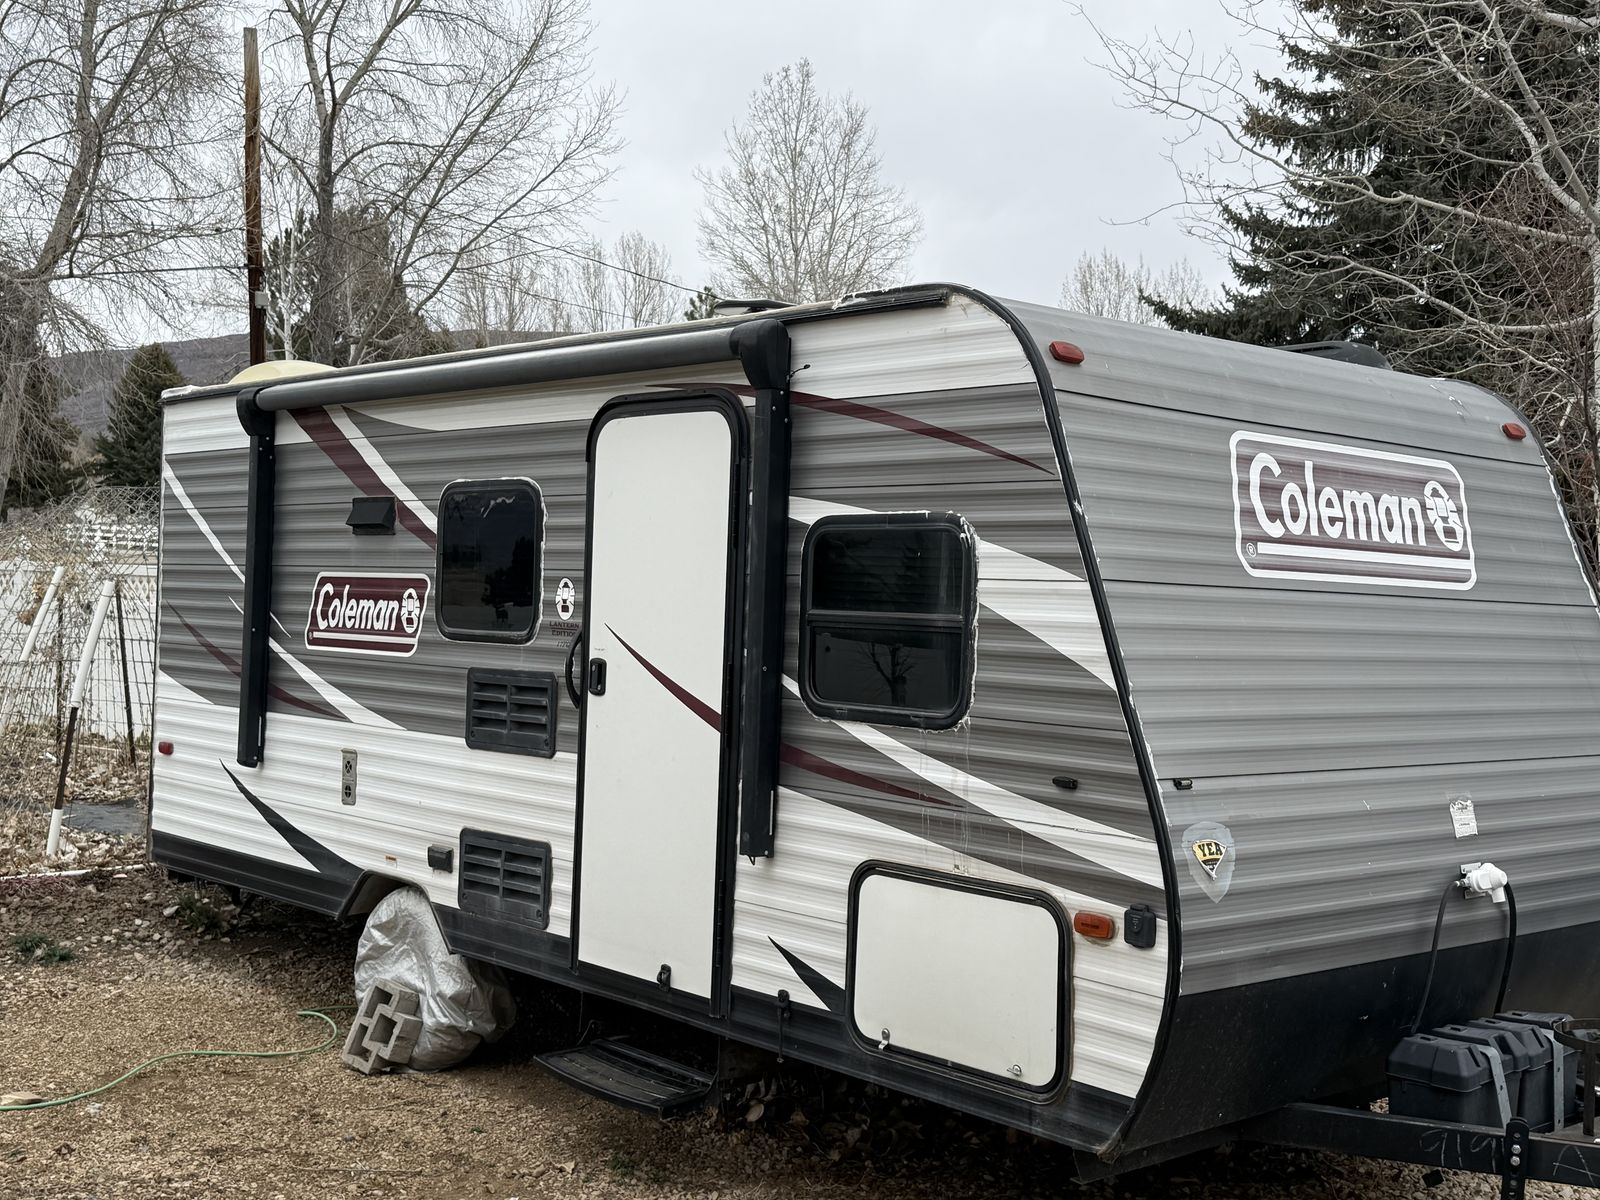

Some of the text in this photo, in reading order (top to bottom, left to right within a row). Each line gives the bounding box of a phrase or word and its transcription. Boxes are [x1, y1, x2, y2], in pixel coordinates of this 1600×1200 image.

[1249, 452, 1427, 547] Coleman
[316, 582, 400, 630] Coleman
[549, 620, 580, 629] LANTERN
[551, 629, 577, 637] EDITIO
